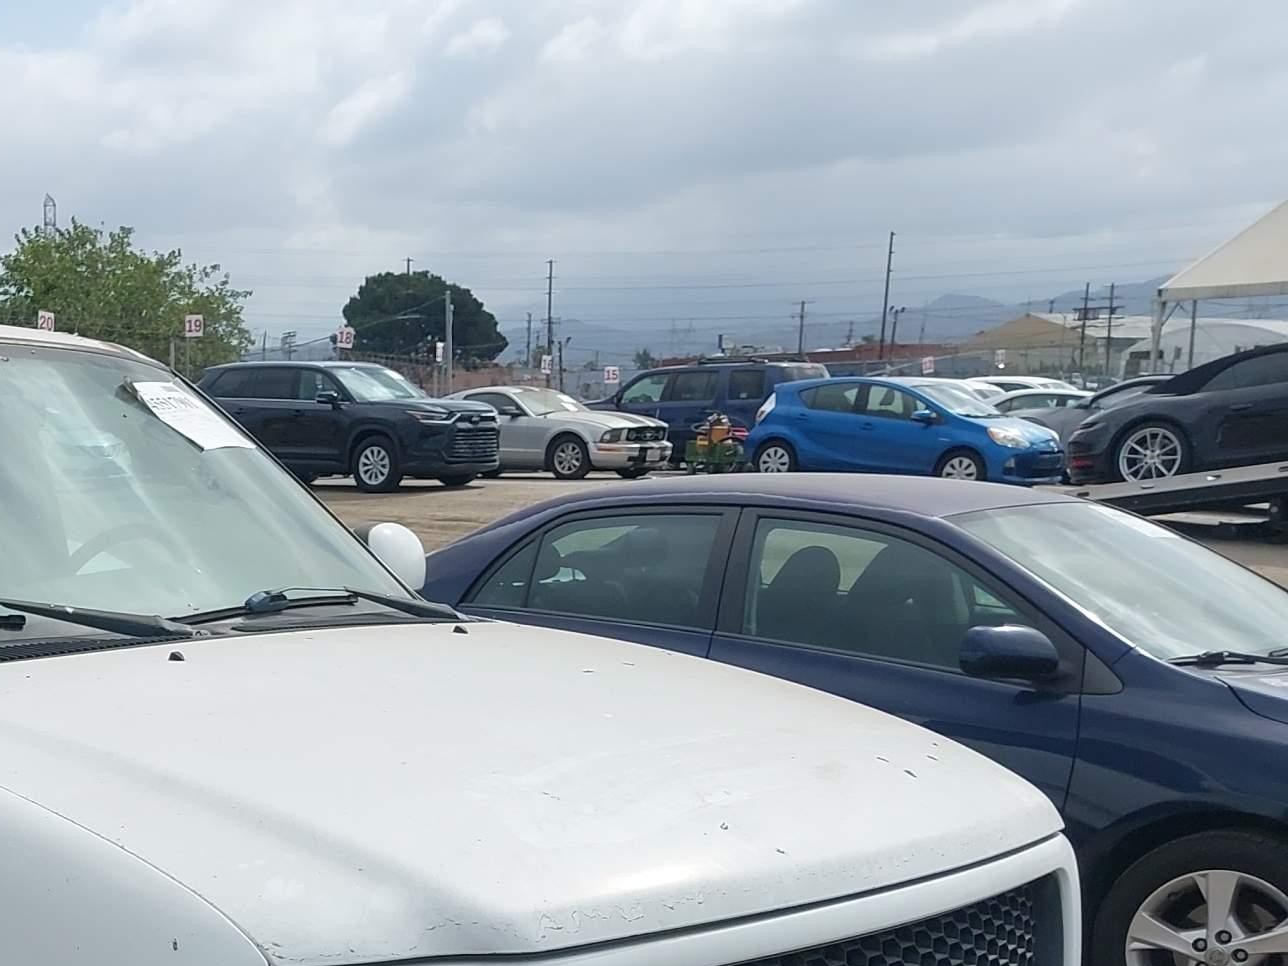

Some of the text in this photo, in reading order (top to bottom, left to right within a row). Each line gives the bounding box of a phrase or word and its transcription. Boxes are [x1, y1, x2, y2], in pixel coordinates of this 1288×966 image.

[39, 316, 53, 332] 20
[186, 319, 202, 333] 19
[337, 331, 353, 345] 18
[606, 369, 618, 381] 15
